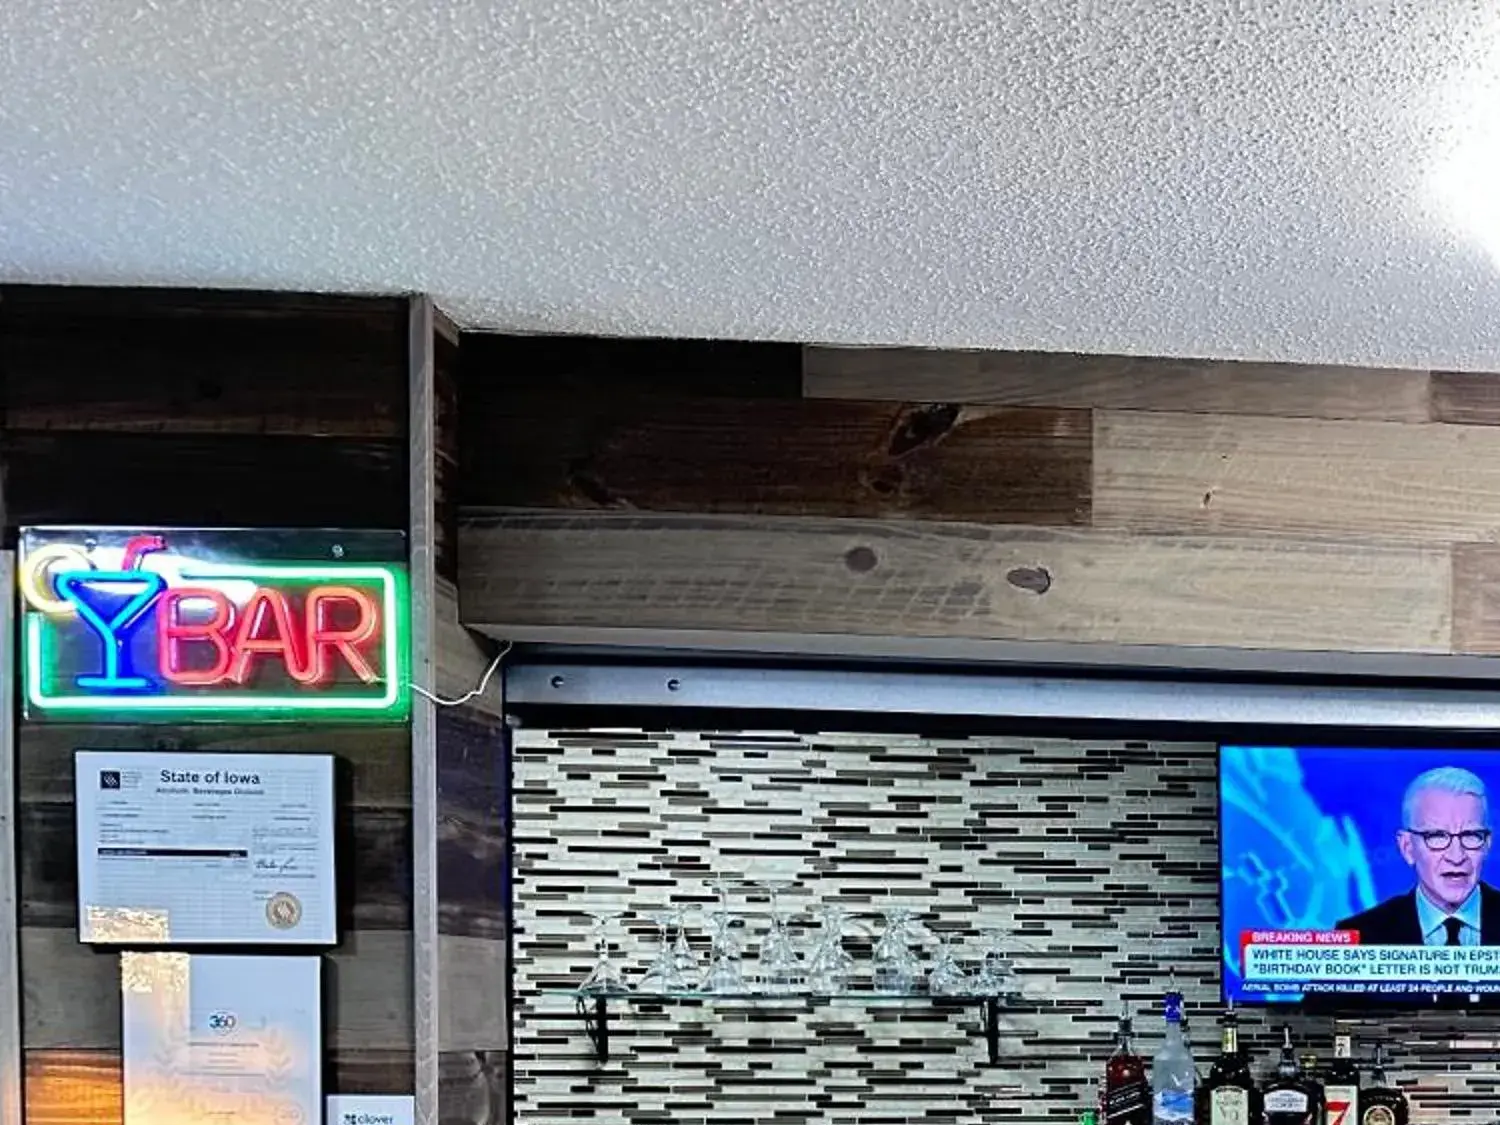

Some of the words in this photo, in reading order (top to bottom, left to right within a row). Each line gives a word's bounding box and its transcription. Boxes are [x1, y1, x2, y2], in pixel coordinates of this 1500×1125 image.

[157, 586, 378, 685] BAR
[161, 769, 200, 783] State
[204, 771, 220, 784] of
[224, 770, 261, 784] Iowa
[1252, 931, 1313, 943] BREAKING
[1315, 932, 1351, 943] NEWS
[1252, 949, 1293, 960] WHITE
[1296, 949, 1340, 960] HOUSE
[1343, 949, 1377, 961] SAYS
[1379, 949, 1451, 961] SIGNATURE
[1453, 950, 1467, 961] IN
[1369, 963, 1417, 975] LETTER
[1419, 963, 1431, 975] IS
[1434, 963, 1461, 975] NOT
[1273, 983, 1300, 992] BOMB
[1301, 983, 1335, 992] ATTACK
[1335, 983, 1366, 992] KILLED
[1367, 983, 1379, 992] AT
[1379, 983, 1407, 993] LEAST
[1420, 984, 1453, 993] PEOPLE
[1455, 984, 1474, 993] AND
[357, 1114, 393, 1125] clover
